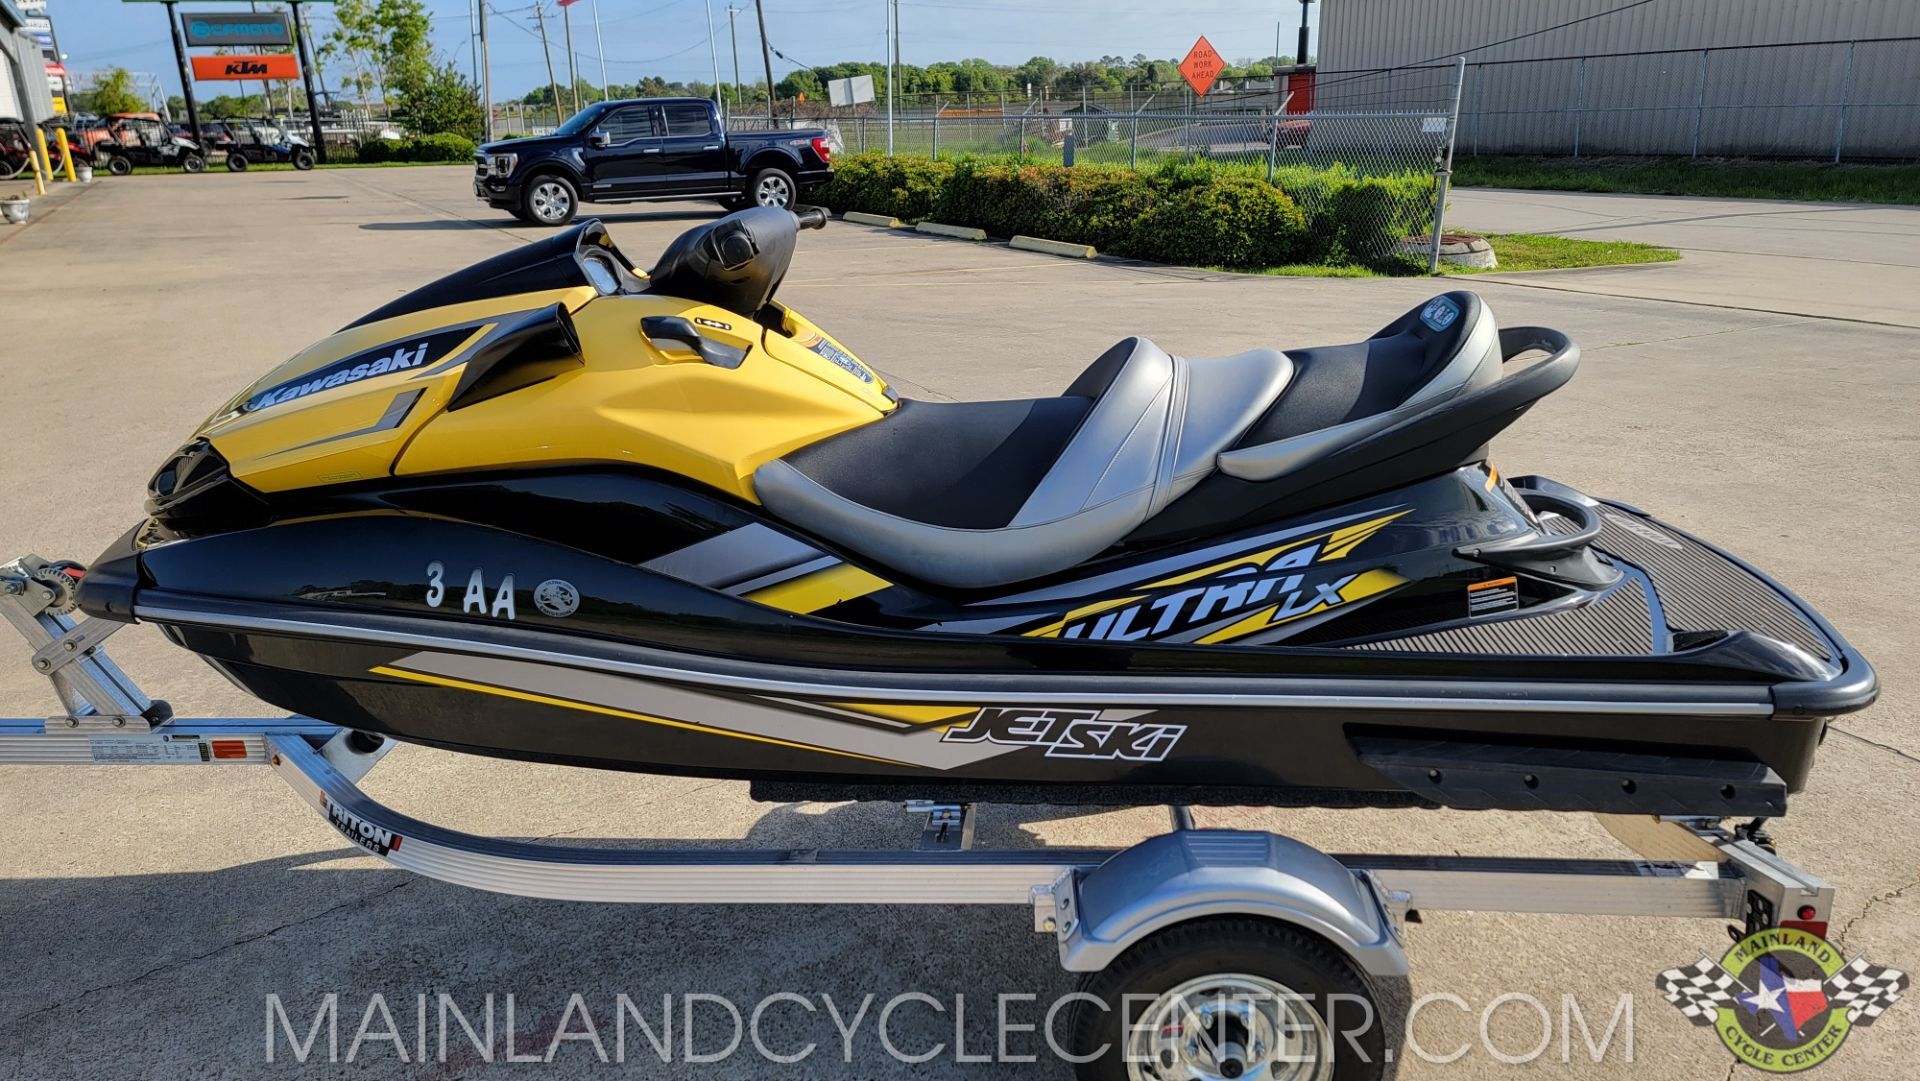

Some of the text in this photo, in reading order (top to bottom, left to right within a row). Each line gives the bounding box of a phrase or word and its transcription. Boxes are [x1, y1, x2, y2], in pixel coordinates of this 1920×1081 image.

[225, 61, 267, 74] KTM
[1191, 70, 1214, 79] AHEAD
[1193, 50, 1213, 59] ROAD
[1193, 60, 1213, 69] WORK
[251, 342, 429, 410] Kawasaki
[426, 560, 516, 621] 3 AA
[1064, 543, 1321, 640] ULTRA
[1271, 573, 1359, 622] LX
[324, 798, 393, 848] TRITON
[335, 819, 380, 853] TRAILERS
